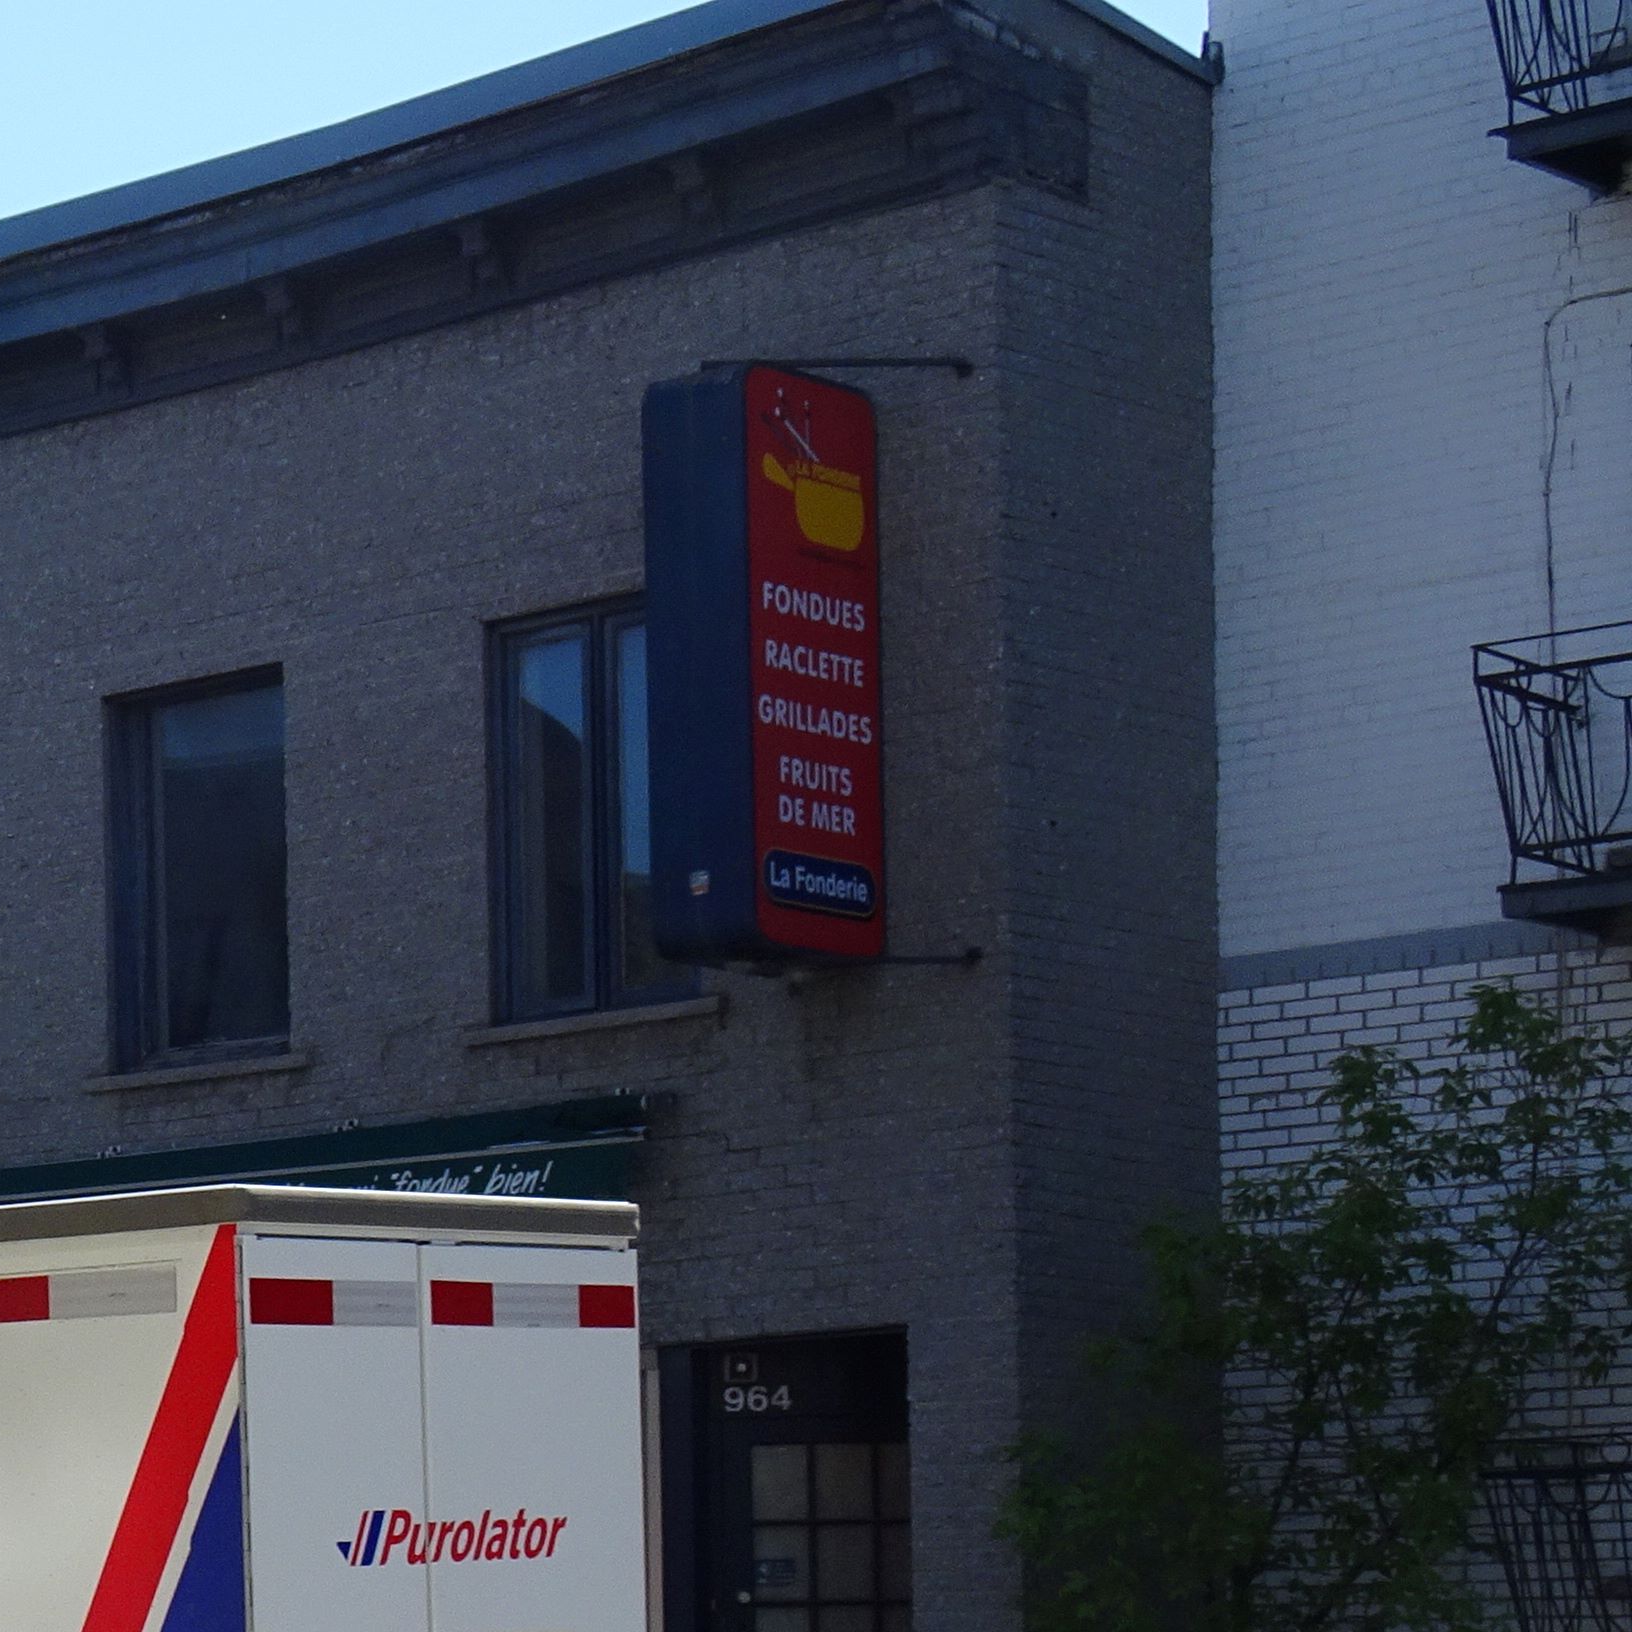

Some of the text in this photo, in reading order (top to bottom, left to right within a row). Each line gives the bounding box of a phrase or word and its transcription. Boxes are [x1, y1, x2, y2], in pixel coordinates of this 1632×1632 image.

[761, 581, 866, 633] FONDUES
[764, 638, 865, 688] RACLETTE
[758, 695, 873, 745] GRILLADES
[779, 755, 854, 798] FRUITS
[777, 793, 856, 836] DE MER
[768, 860, 869, 904] La Fonderie
[484, 1160, 554, 1195] bien!
[722, 1383, 794, 1413] 964
[378, 1506, 568, 1569] Purolator
